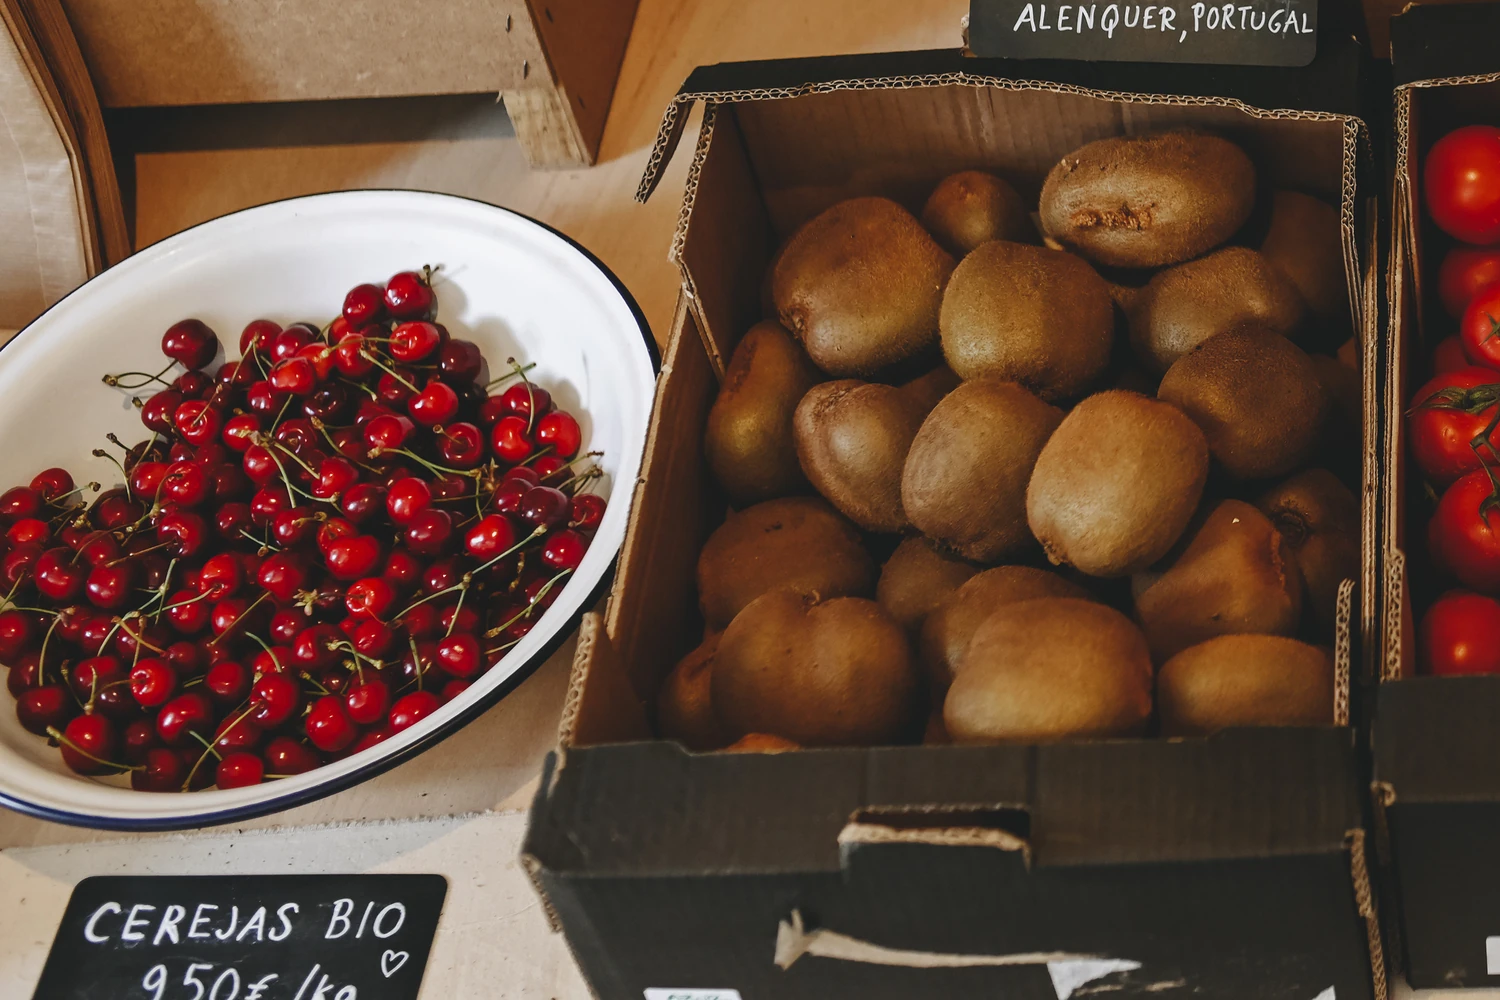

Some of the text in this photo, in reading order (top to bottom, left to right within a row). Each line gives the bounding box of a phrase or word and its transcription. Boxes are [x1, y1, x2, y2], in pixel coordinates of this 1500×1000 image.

[1192, 2, 1315, 35] PORTUGAL
[83, 897, 408, 947] CEREJAS BIO
